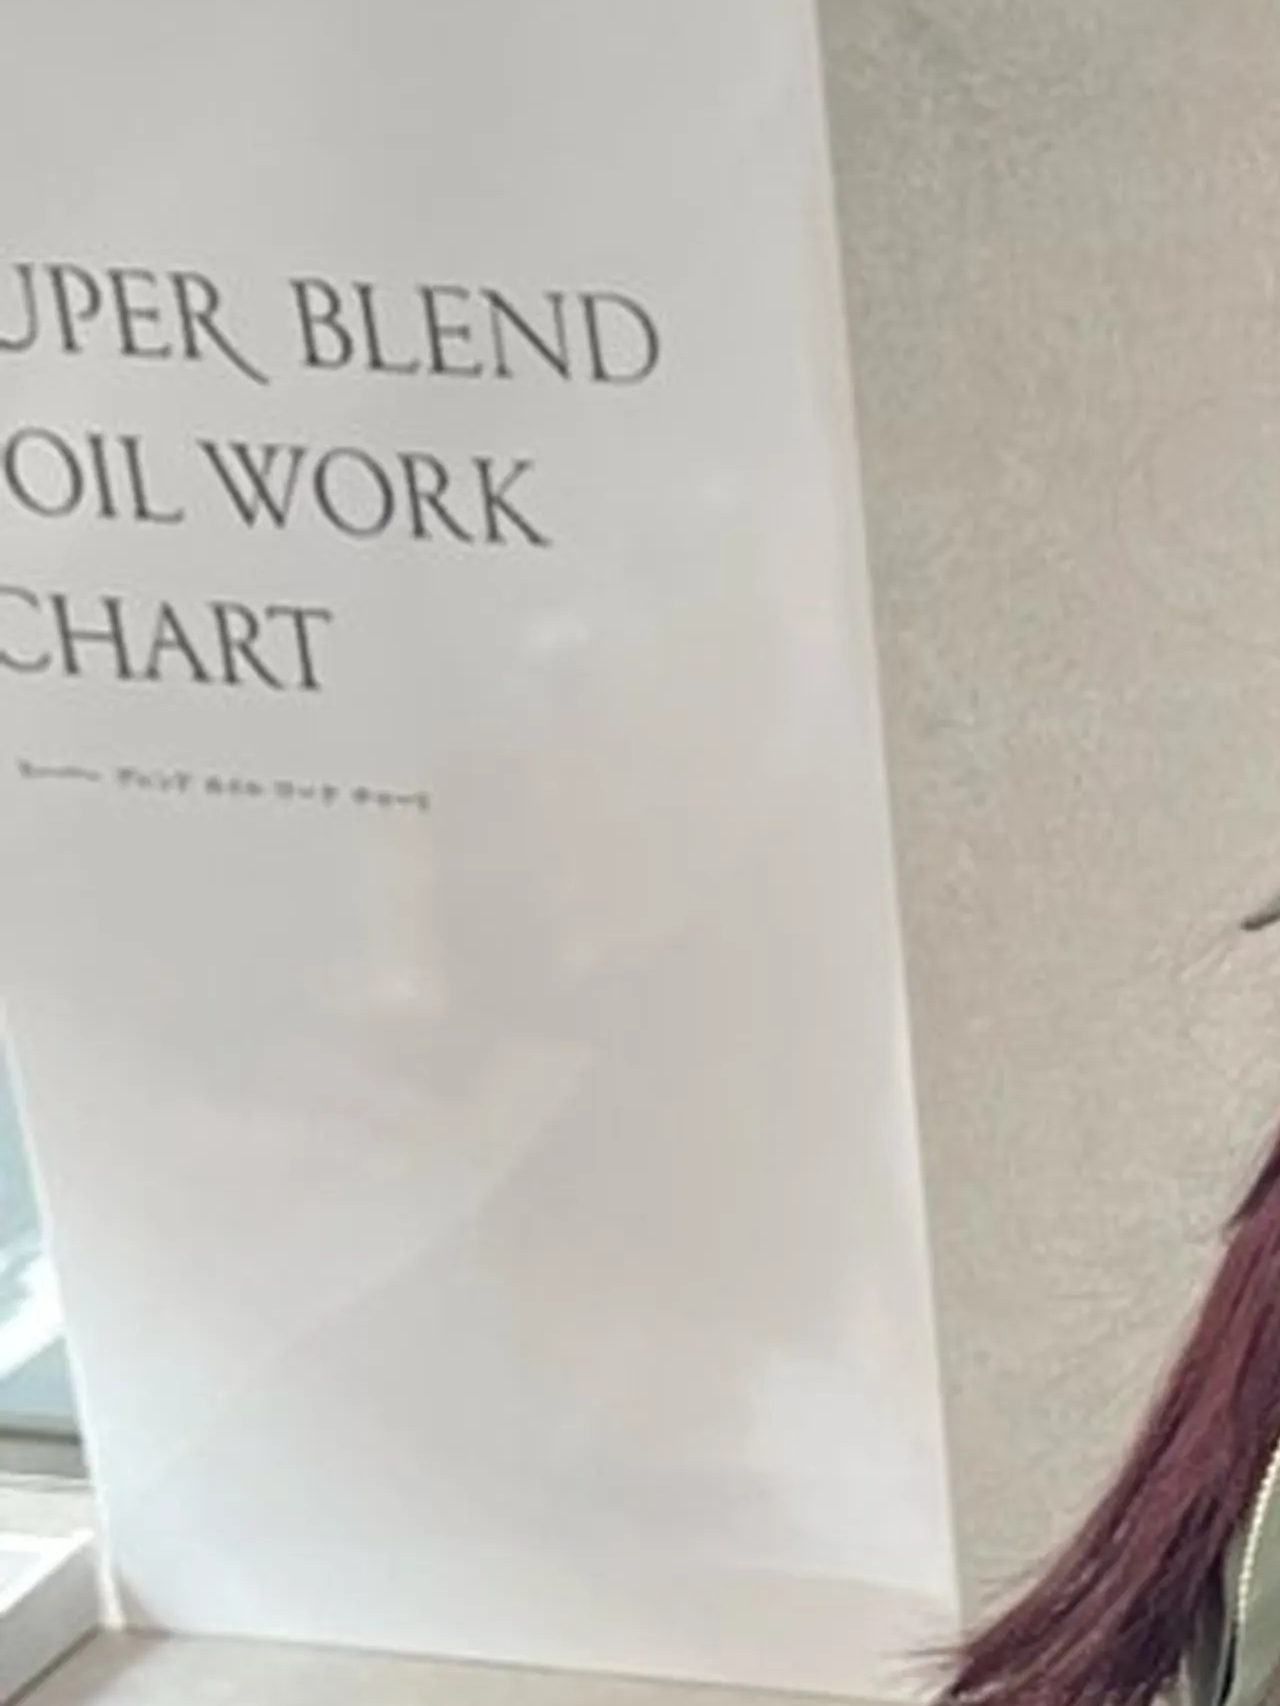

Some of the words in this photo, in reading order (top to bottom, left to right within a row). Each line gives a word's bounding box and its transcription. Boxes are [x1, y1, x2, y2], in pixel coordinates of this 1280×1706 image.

[289, 278, 660, 386] BLEND
[3, 426, 185, 525] OIL
[197, 438, 553, 548] WORK
[0, 586, 334, 692] CHART
